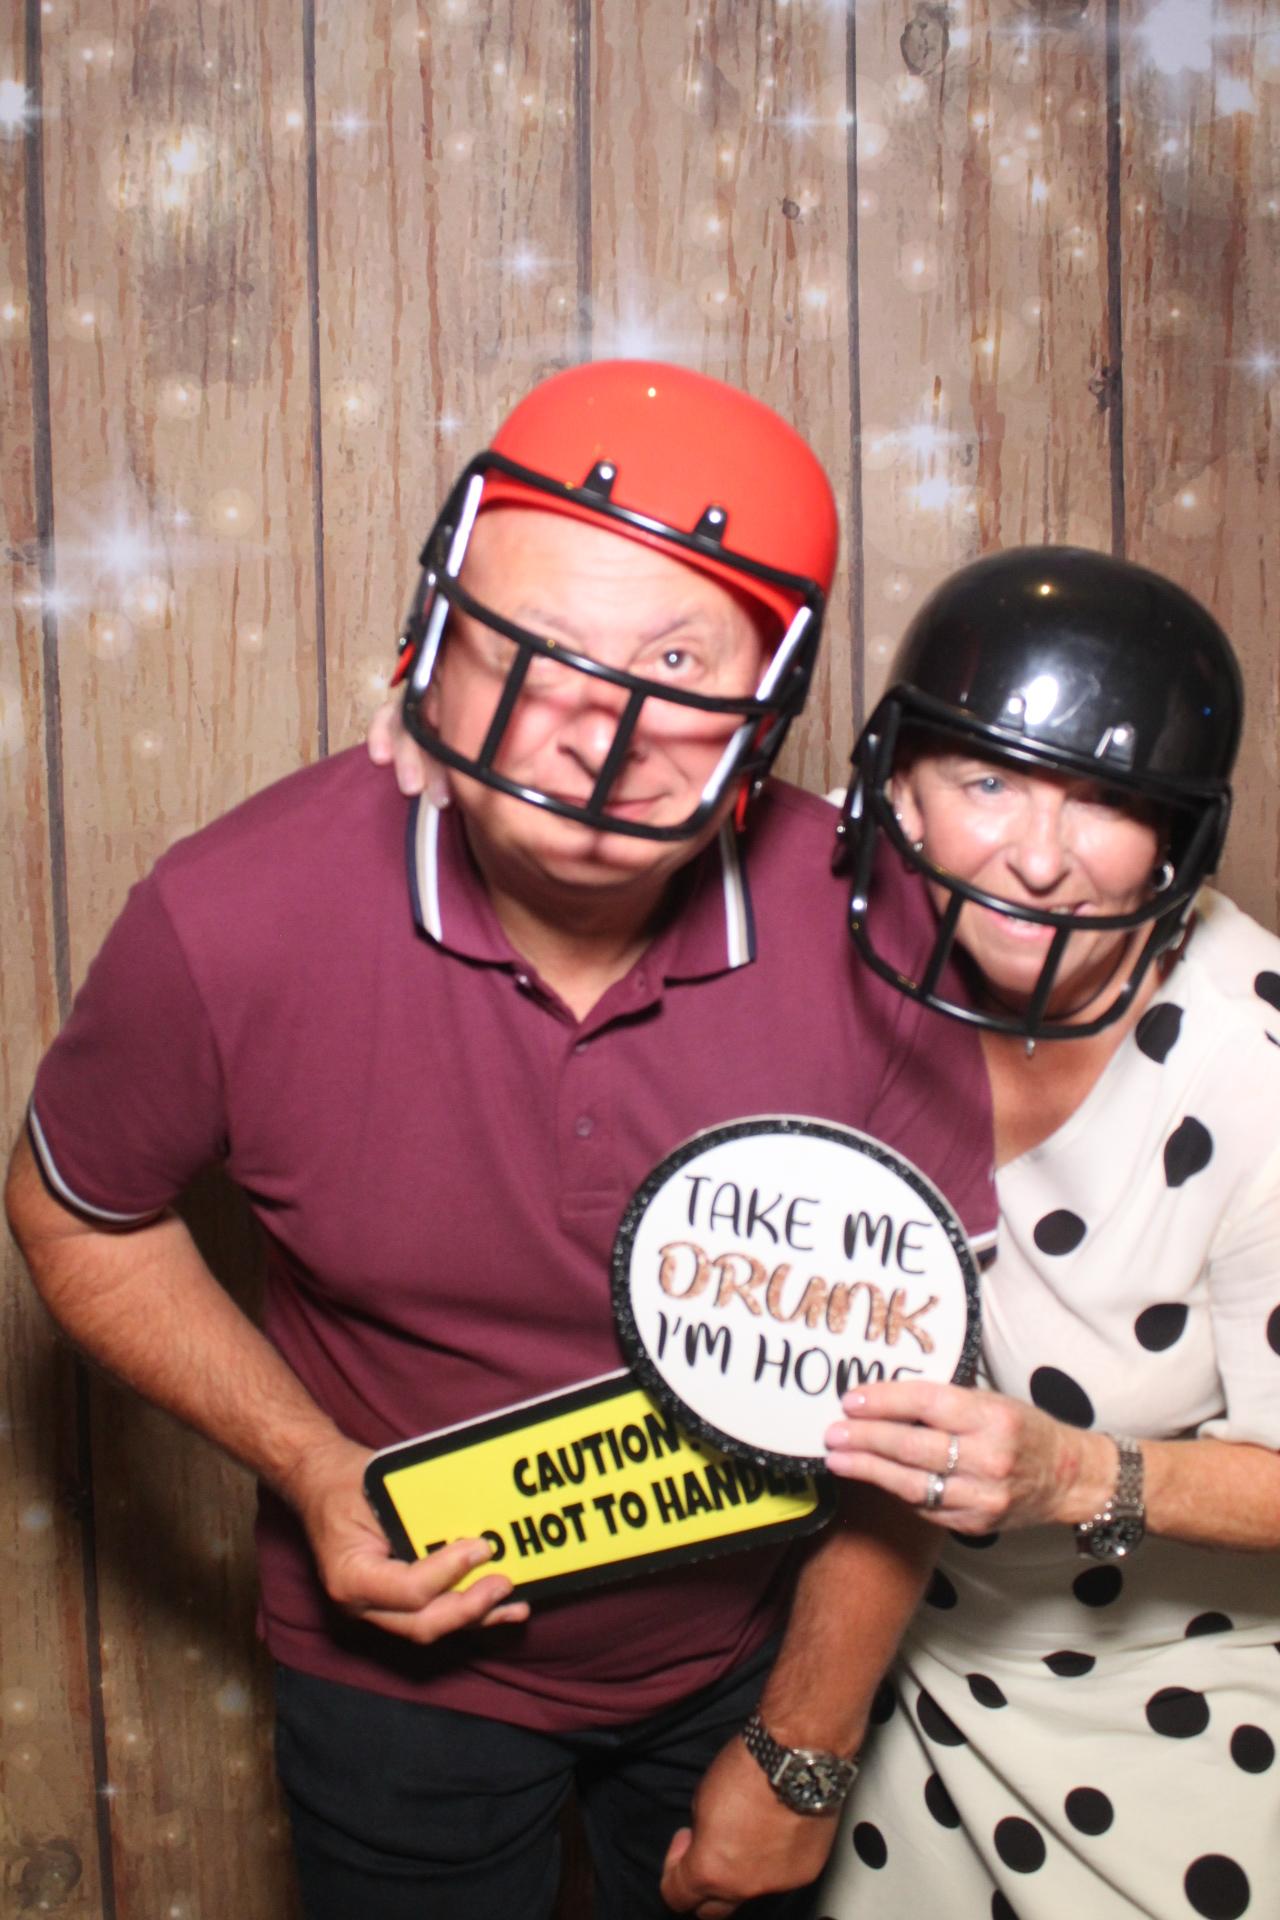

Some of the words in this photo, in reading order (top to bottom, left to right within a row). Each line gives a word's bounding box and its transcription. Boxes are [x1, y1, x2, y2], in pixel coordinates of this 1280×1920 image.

[685, 1175, 820, 1251] TAKE
[843, 1211, 933, 1275] ME
[658, 1241, 940, 1355] DRUNK
[658, 1311, 732, 1376] I'M
[754, 1334, 924, 1401] HOM
[510, 1503, 587, 1559] HOT
[592, 1490, 648, 1536] TO
